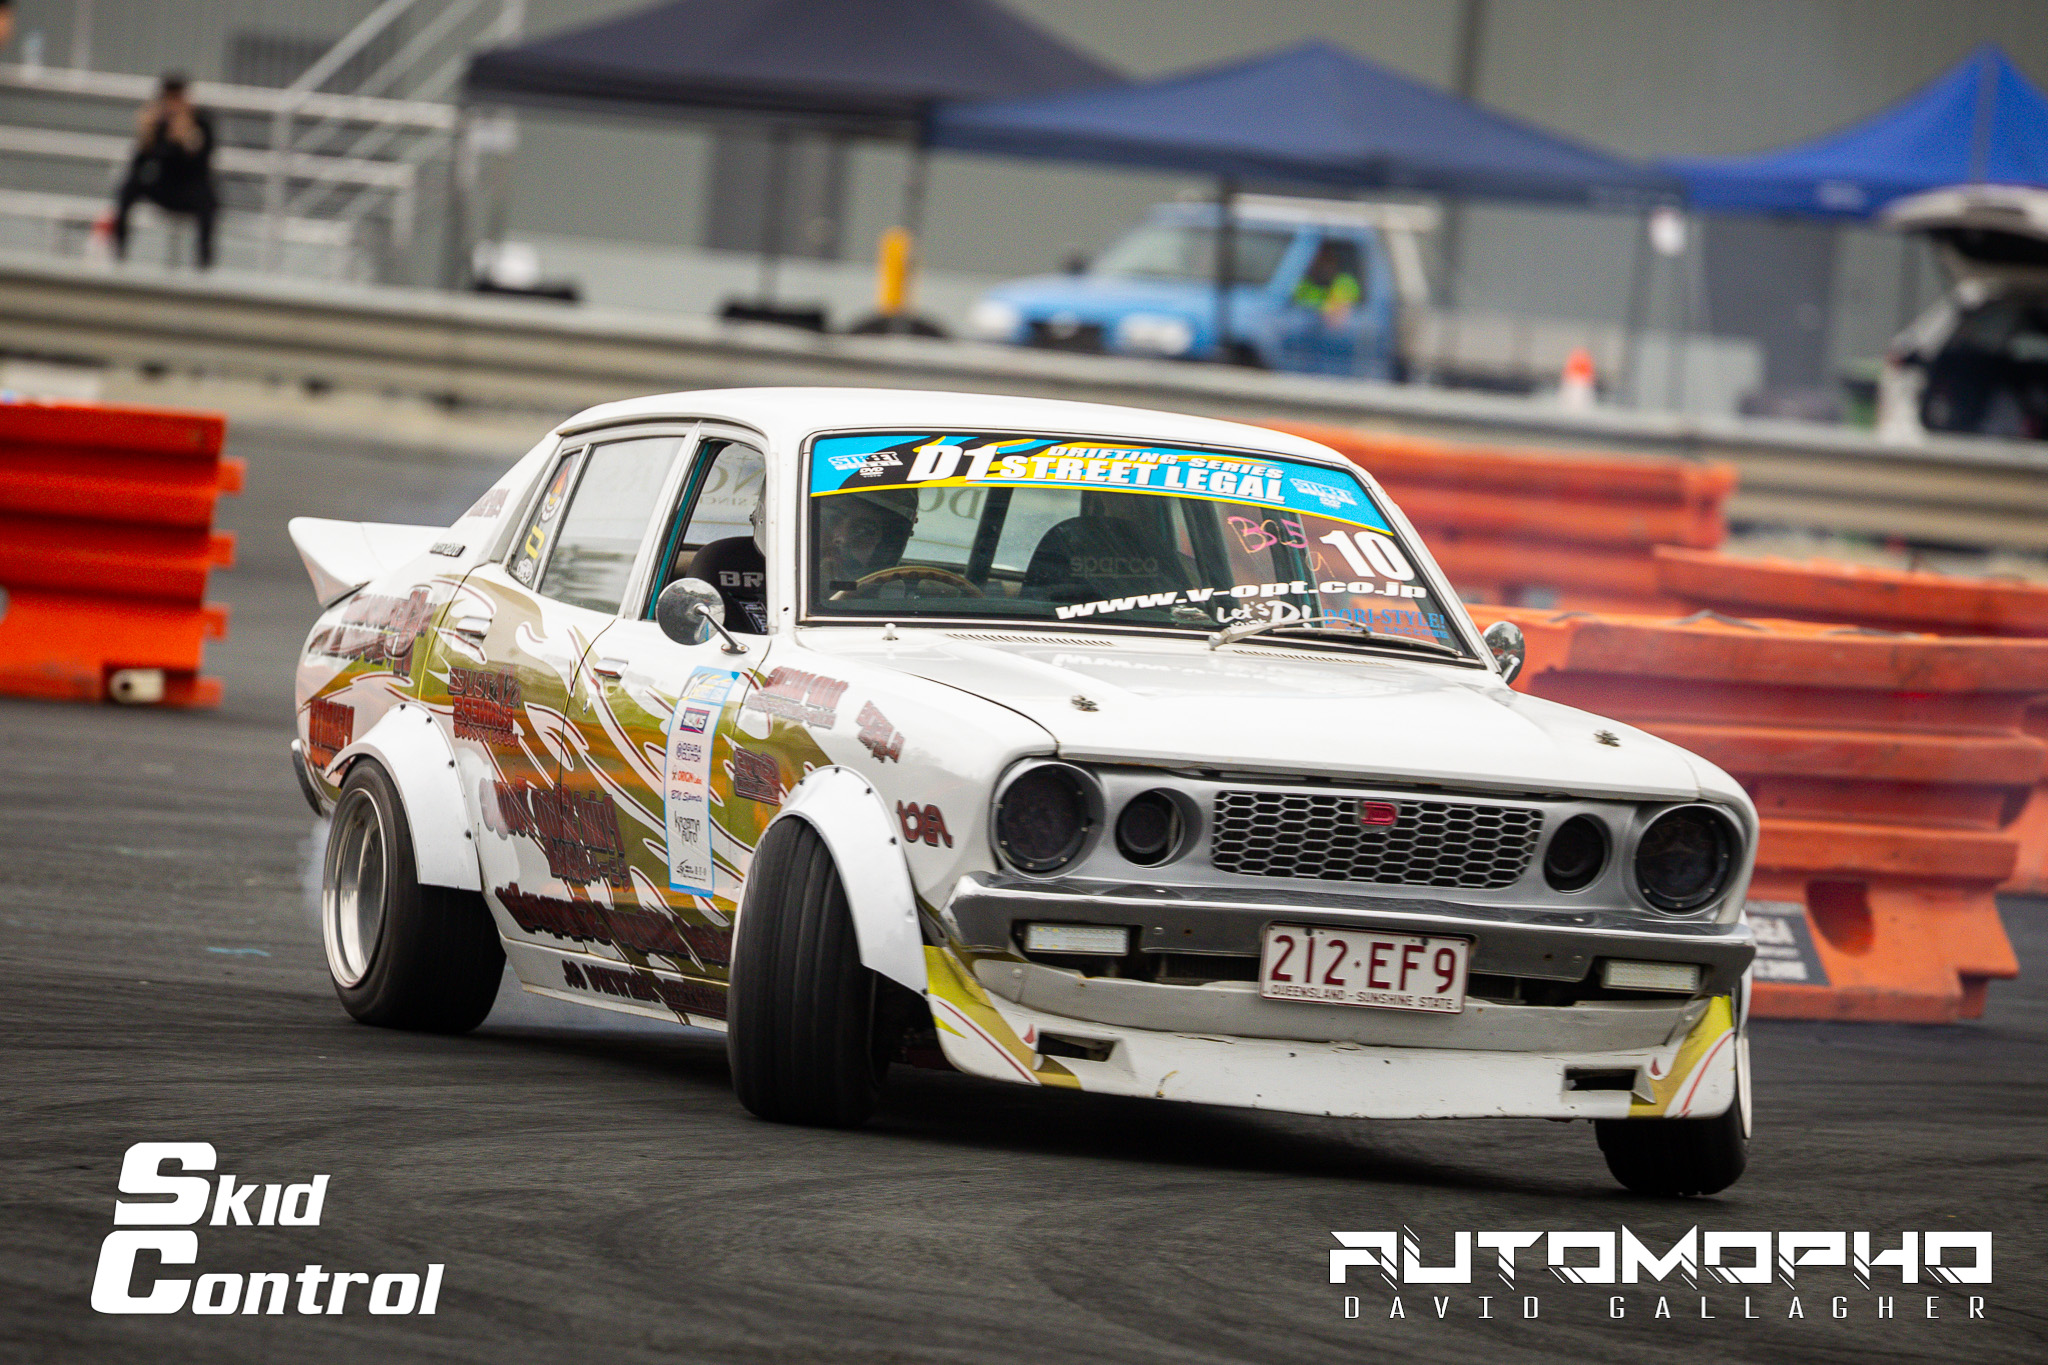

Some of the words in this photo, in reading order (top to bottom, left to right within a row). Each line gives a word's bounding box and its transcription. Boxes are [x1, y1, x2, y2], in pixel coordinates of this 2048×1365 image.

[906, 444, 999, 482] D1
[1000, 455, 1162, 486] STREET
[1164, 464, 1286, 502] LEGAL
[1046, 445, 1179, 466] DRIFTING
[1187, 457, 1285, 479] SERIES
[1319, 529, 1416, 582] 10
[1055, 580, 1428, 619] www.v-opt.co.jp
[1217, 601, 1270, 624] Let's
[1265, 600, 1312, 629] D!
[1323, 608, 1446, 629] DORI-STYLE!
[1270, 984, 1347, 1000] QUEENSLAND
[1357, 991, 1414, 1007] SUNSHINE
[1418, 996, 1455, 1010] STATE
